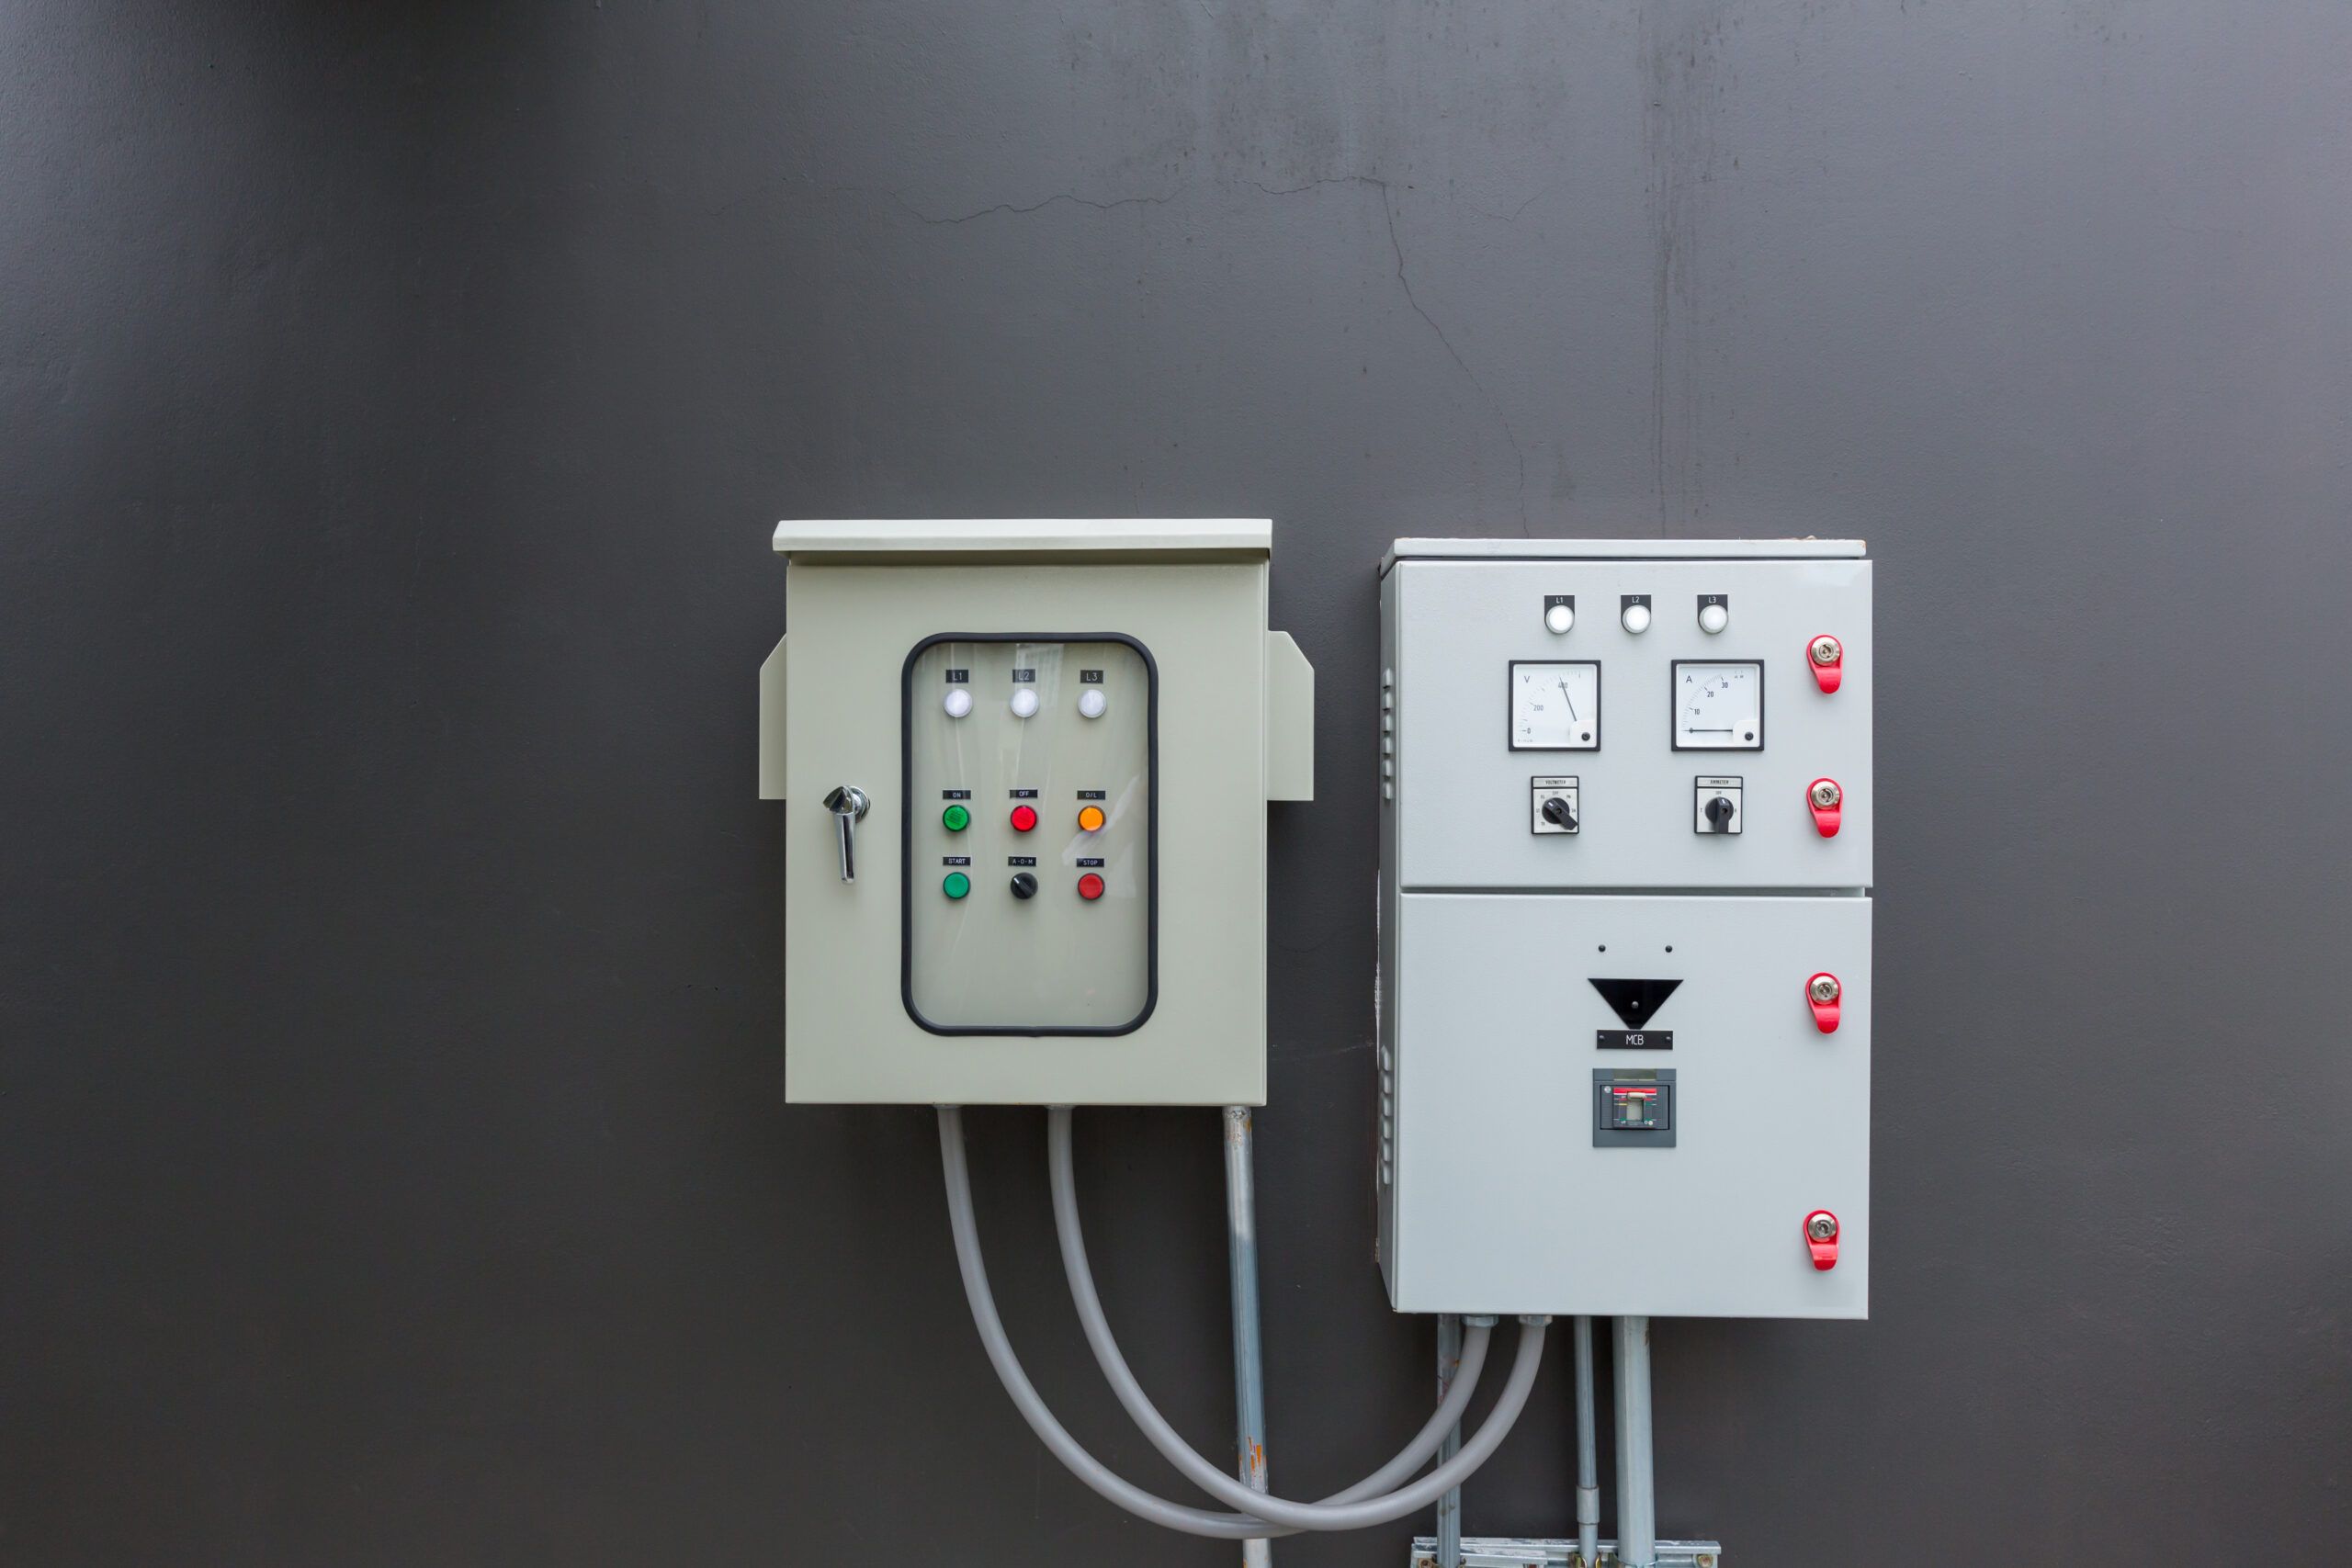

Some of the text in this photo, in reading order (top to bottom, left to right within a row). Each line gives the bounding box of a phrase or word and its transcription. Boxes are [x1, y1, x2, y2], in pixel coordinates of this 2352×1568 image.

[952, 671, 963, 681] L1
[1018, 671, 1030, 681] L2
[1086, 671, 1098, 682] L3
[1523, 675, 1531, 683] V
[1685, 675, 1692, 683] A
[1625, 1034, 1645, 1045] MCB
